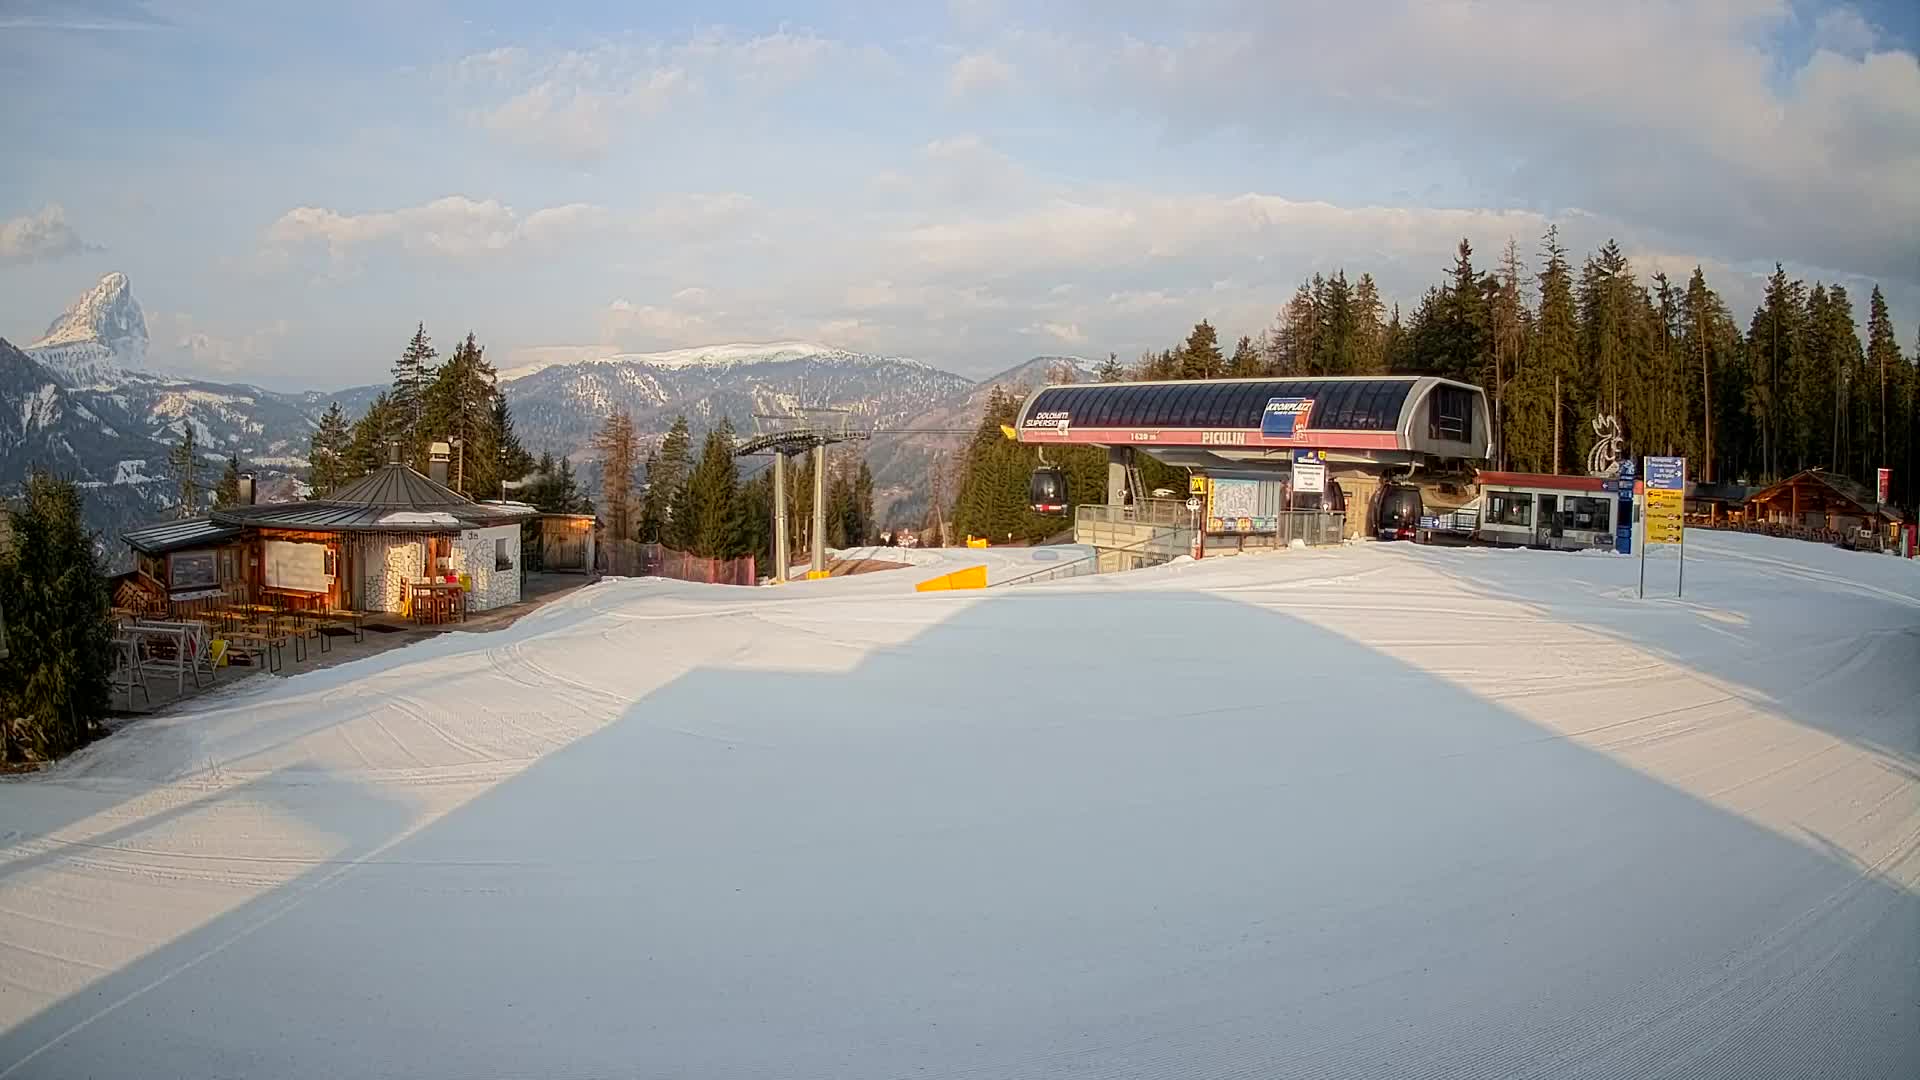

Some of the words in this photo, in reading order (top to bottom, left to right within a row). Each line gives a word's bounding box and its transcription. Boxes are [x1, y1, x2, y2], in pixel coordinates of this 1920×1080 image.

[1265, 402, 1312, 411] KRONPLATZ
[1036, 411, 1069, 420] DOLOMITI
[1202, 431, 1245, 445] PICULIN
